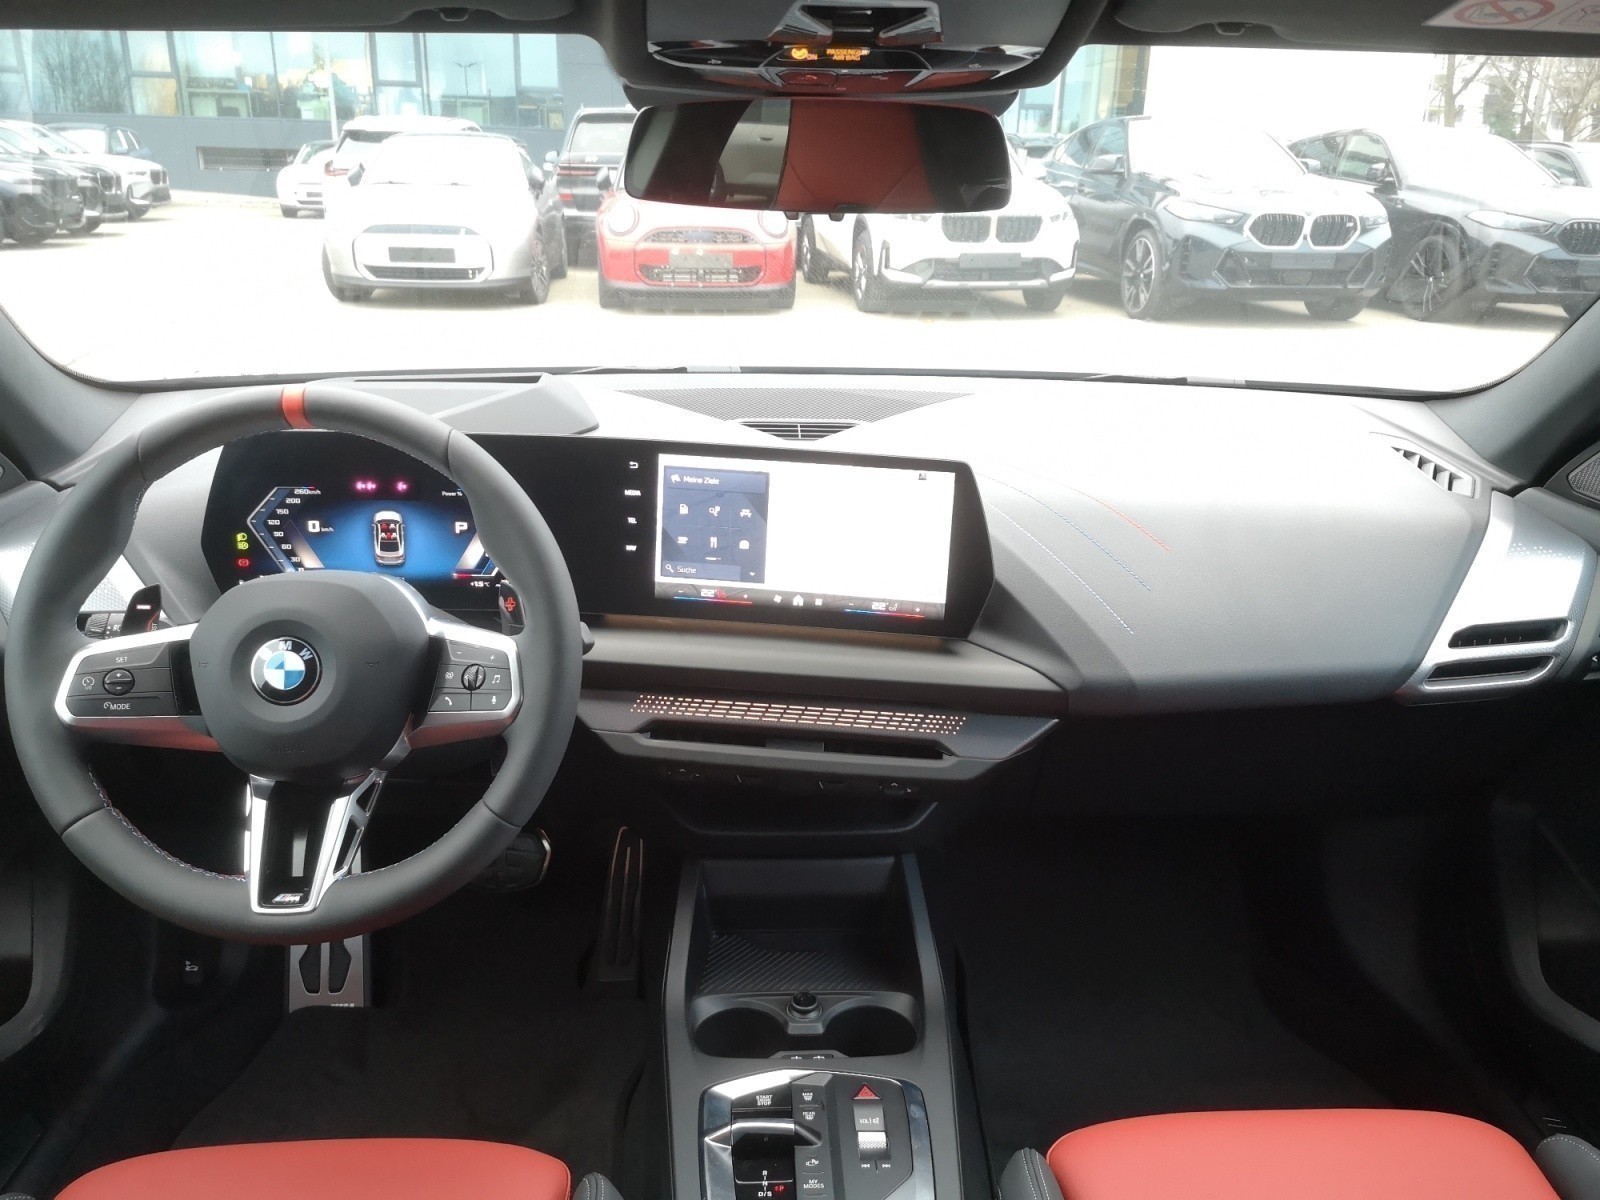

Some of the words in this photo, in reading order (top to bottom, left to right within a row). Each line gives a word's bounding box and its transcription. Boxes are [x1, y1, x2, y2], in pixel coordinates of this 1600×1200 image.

[683, 475, 702, 484] Meine
[703, 477, 720, 485] Ziele
[455, 521, 468, 534] P
[677, 565, 697, 574] Suche
[109, 702, 131, 710] MODE
